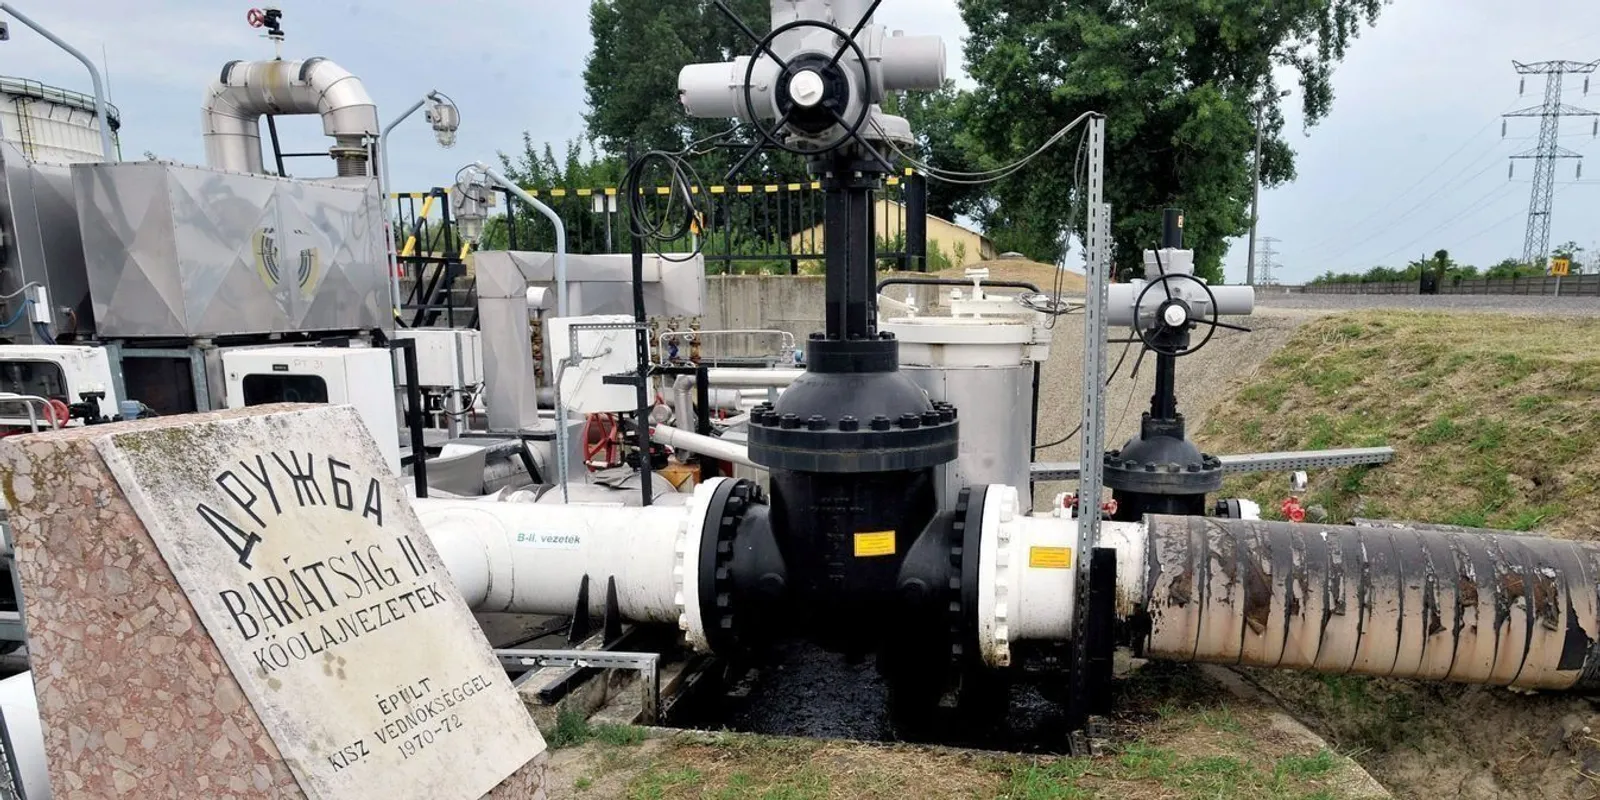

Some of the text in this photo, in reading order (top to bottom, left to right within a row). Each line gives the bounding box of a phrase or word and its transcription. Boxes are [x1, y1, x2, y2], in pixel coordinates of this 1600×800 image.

[196, 450, 383, 570] ДРУЖБА
[219, 538, 402, 641] BARÁTSÁG
[327, 674, 493, 773] KISZ VÉDNÖKSÉGGEL
[376, 677, 432, 716] ÉPÜLT
[398, 713, 463, 760] 1970-72
